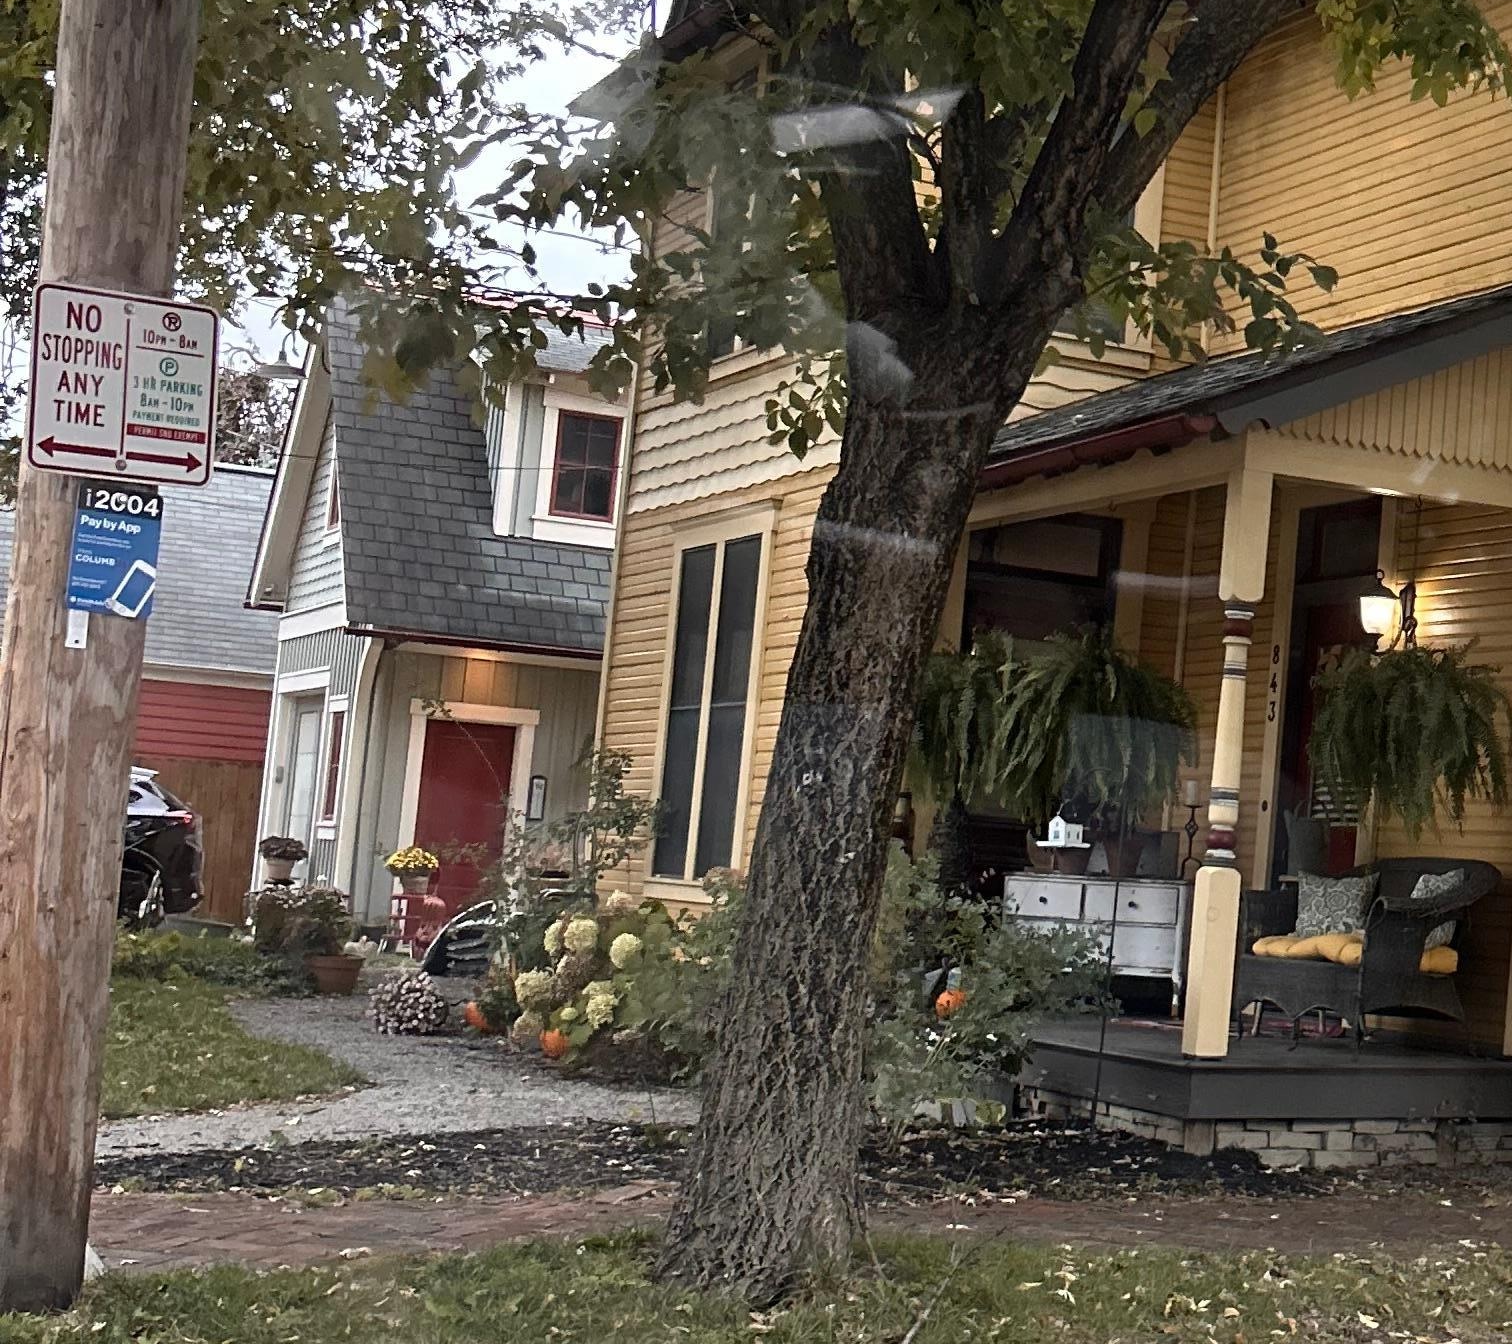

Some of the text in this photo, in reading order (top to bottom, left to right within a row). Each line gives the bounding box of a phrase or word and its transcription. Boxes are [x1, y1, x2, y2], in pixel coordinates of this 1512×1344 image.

[66, 301, 102, 333] NO
[42, 333, 122, 370] STOPPING
[143, 329, 167, 345] 10PM
[179, 334, 198, 350] 8AM
[57, 370, 104, 397] ANY
[143, 376, 157, 390] HR
[160, 379, 203, 397] PARKING
[53, 399, 106, 427] TIME
[140, 392, 160, 408] 8AM
[170, 396, 194, 413] 10PM
[80, 514, 141, 535] Pay by App
[1267, 644, 1280, 722] 843
